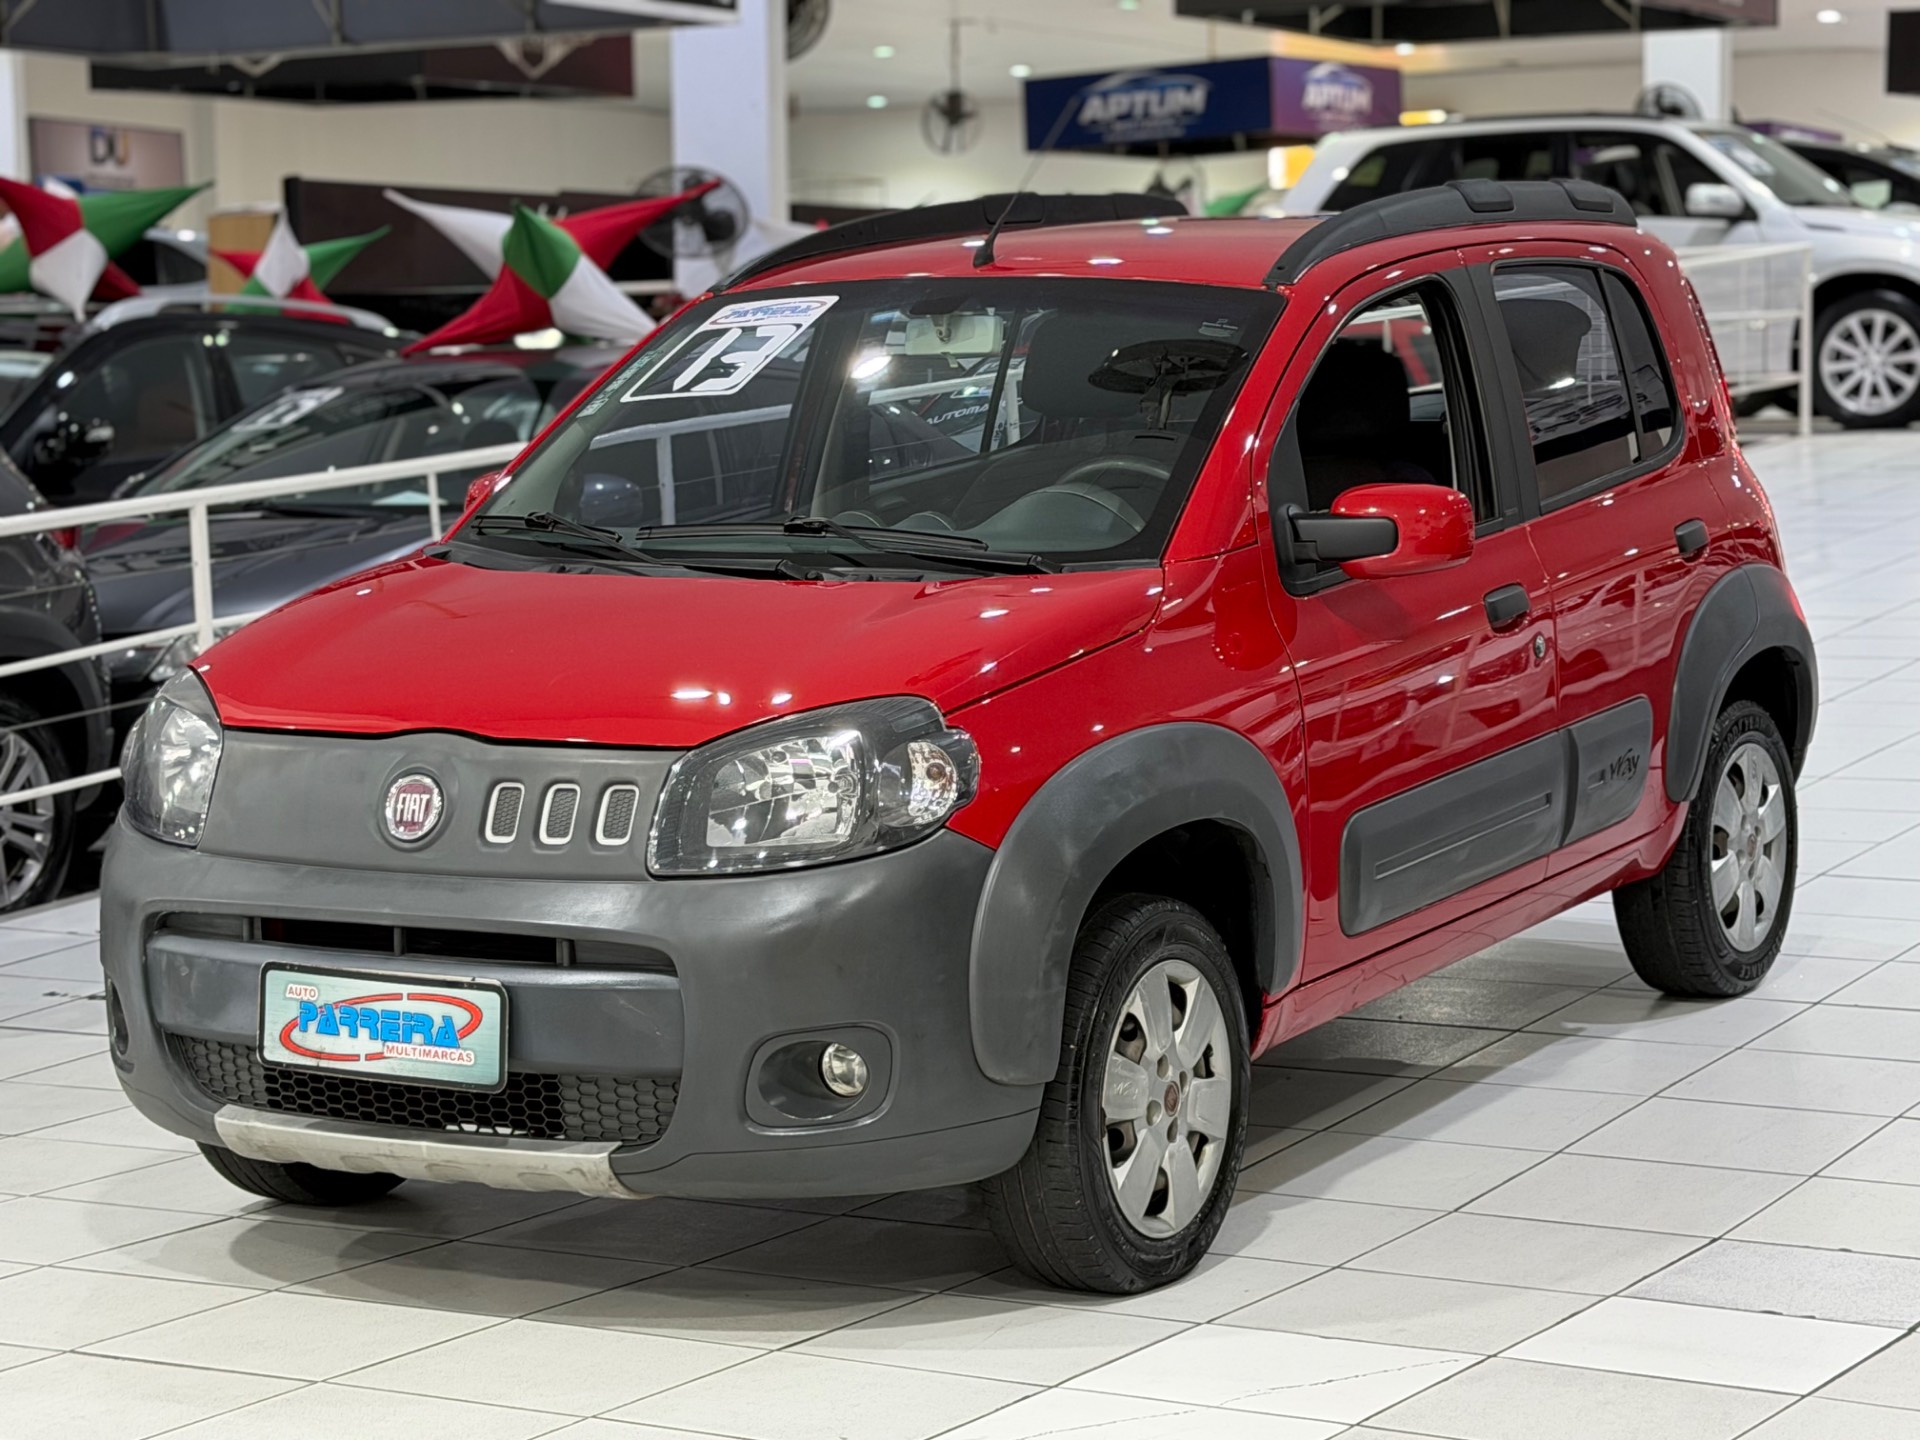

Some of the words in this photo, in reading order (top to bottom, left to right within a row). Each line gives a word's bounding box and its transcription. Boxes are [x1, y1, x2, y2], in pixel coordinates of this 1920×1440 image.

[1078, 84, 1208, 126] APTUM
[672, 325, 797, 392] 13
[396, 794, 431, 822] FIAT
[287, 985, 317, 998] AUTO
[299, 1001, 461, 1049] PARREIRA
[385, 1044, 473, 1063] MULTIMARCAS
